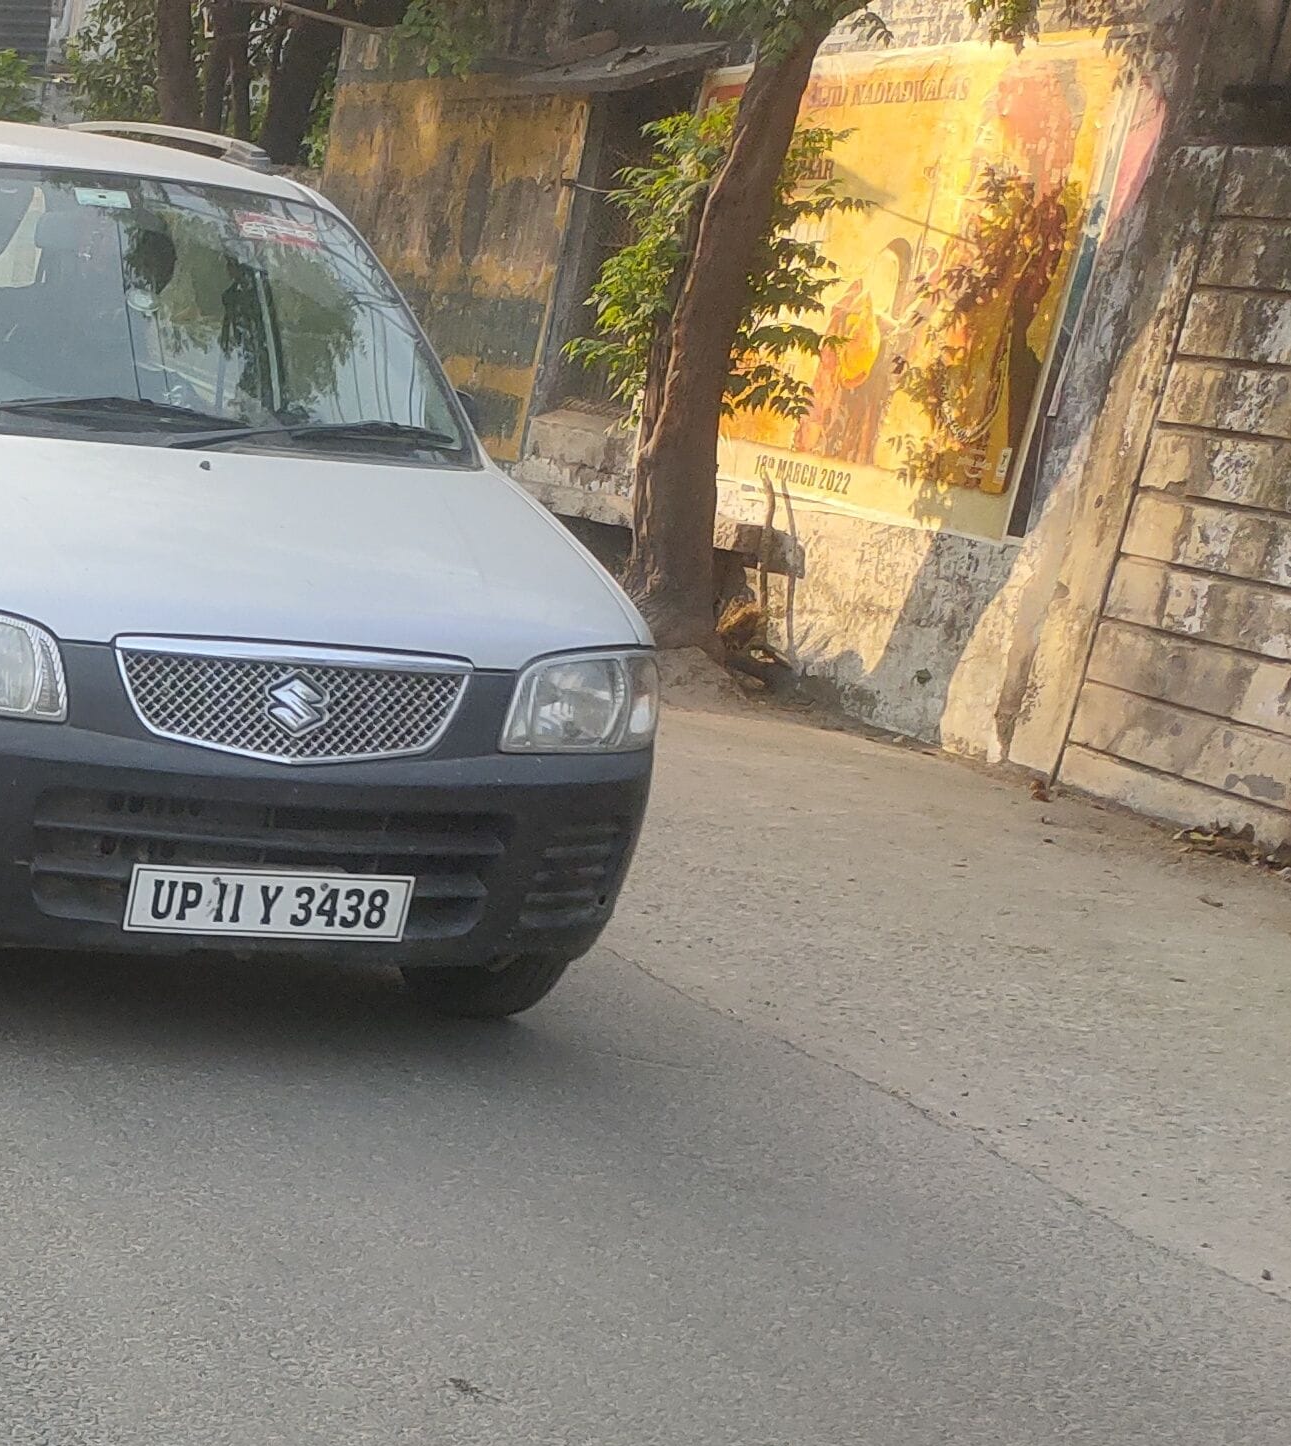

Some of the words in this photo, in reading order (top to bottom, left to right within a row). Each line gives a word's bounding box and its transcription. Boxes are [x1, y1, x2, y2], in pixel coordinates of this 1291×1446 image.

[775, 458, 817, 487] MARCH
[818, 468, 851, 494] 2022
[151, 879, 203, 920] UP
[289, 886, 390, 929] 3438
